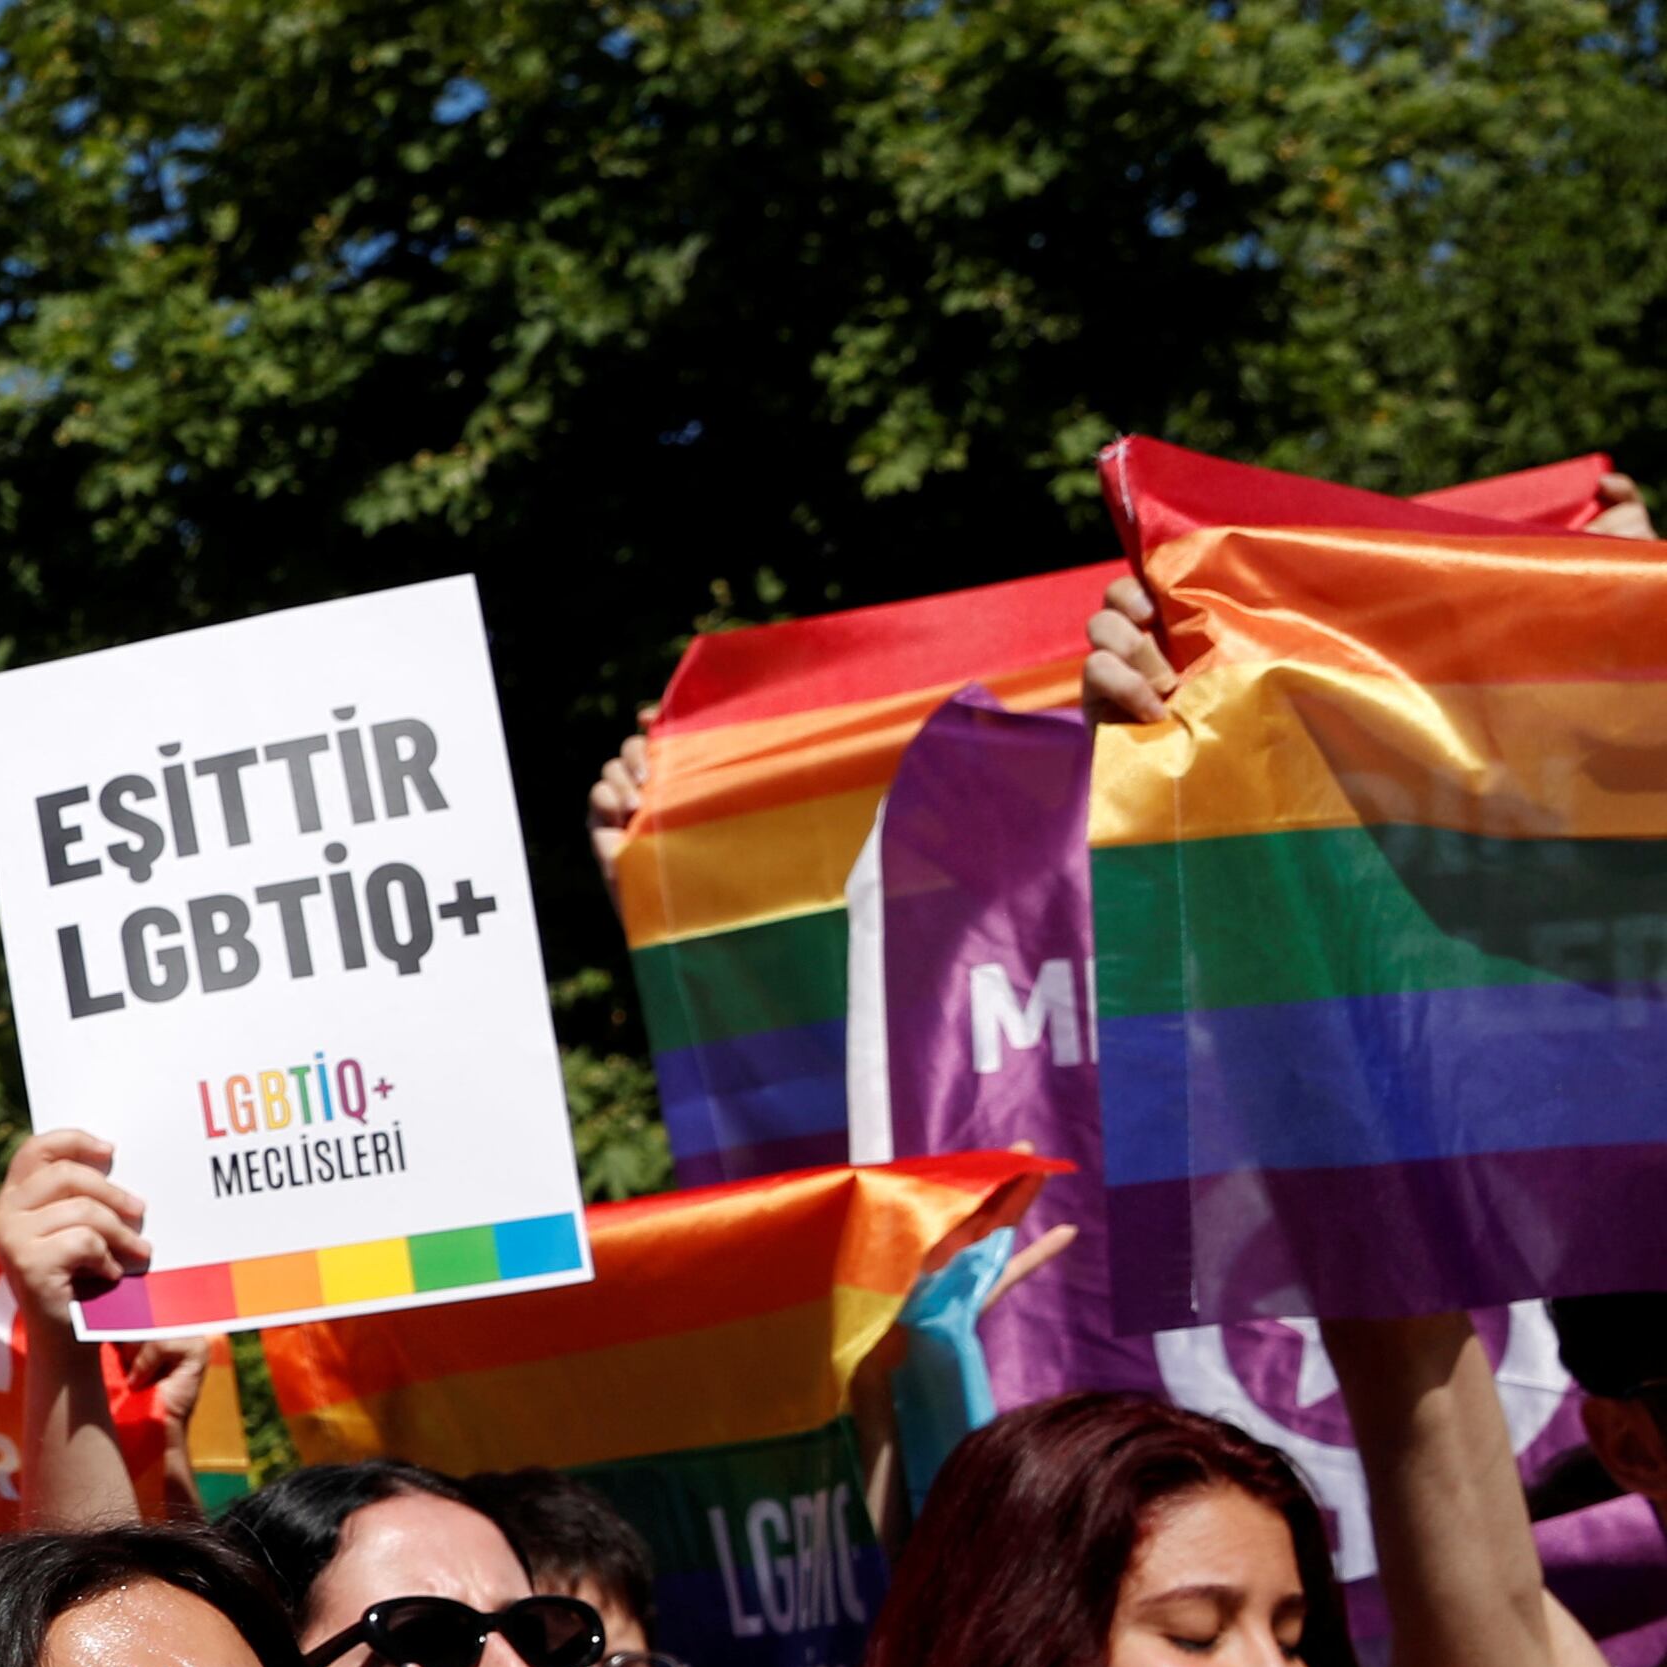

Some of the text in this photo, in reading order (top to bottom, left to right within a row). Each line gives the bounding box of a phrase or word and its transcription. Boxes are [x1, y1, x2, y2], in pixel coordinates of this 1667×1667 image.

[34, 705, 450, 888] EŞİTTİR
[55, 842, 498, 1020] LGBTİQ+
[970, 957, 1099, 1074] M
[197, 1051, 395, 1140] LGBTİQ+
[210, 1120, 407, 1199] MECLİSLERİ
